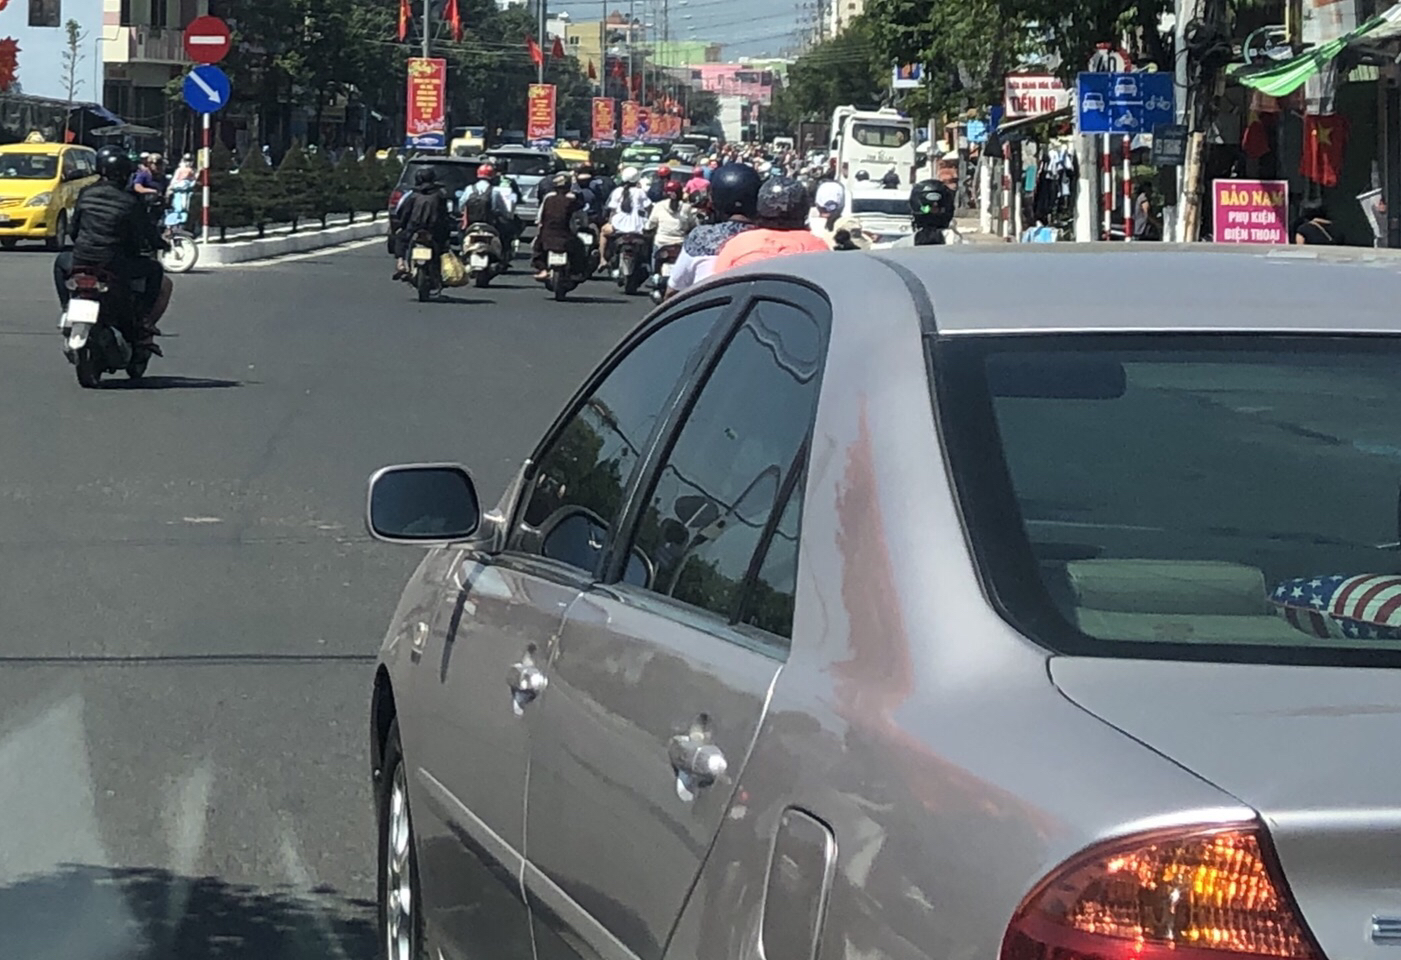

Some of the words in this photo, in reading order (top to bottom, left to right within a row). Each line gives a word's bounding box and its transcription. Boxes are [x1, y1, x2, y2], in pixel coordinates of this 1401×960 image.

[1220, 184, 1249, 206] BẢO
[1251, 190, 1284, 207] NAM
[1228, 211, 1249, 225] PHỤ
[1251, 209, 1276, 225] KIỆN
[1224, 226, 1249, 243] ĐIỆN
[1250, 228, 1280, 244] THOẠI
